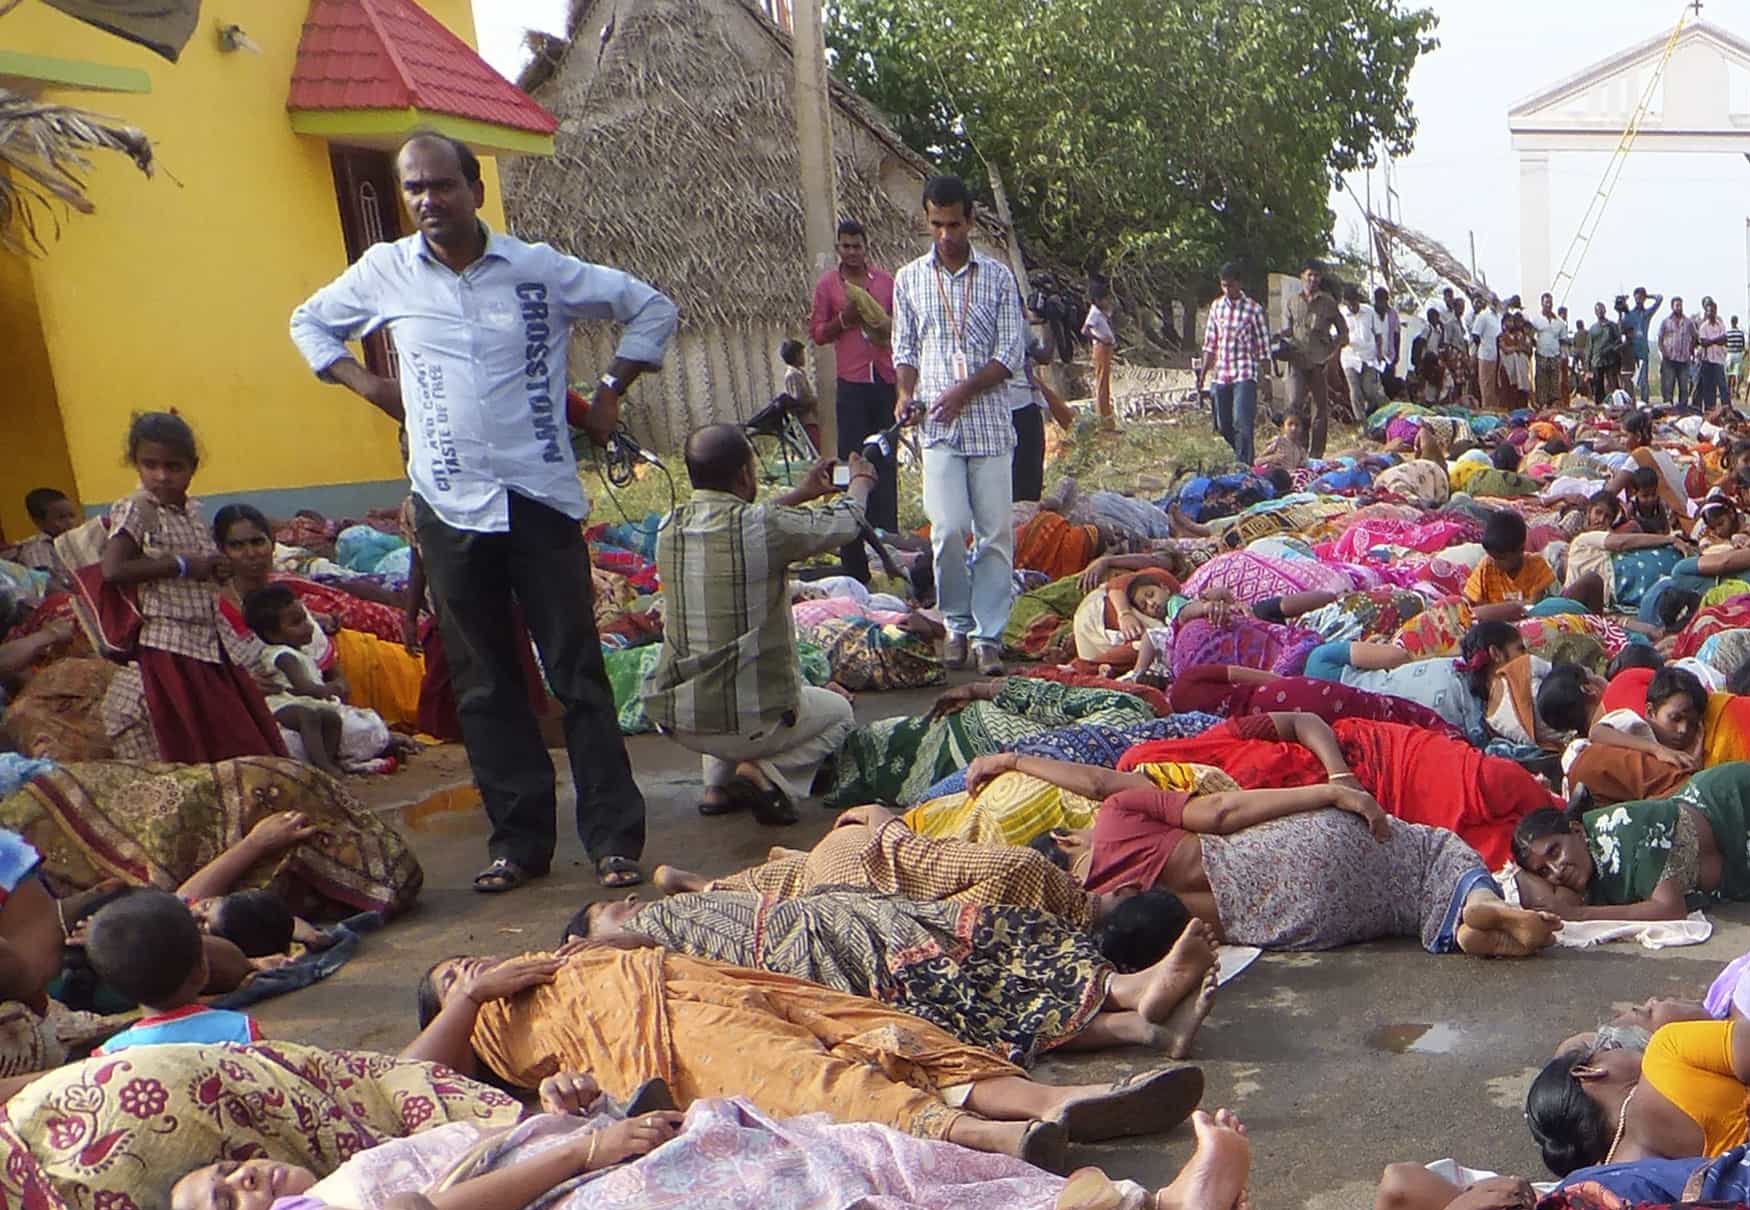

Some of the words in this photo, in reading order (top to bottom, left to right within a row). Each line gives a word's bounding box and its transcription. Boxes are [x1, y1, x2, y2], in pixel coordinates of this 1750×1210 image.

[515, 282, 565, 464] CROSSTOWN
[431, 457, 452, 493] CITY
[439, 429, 462, 476] TASTE
